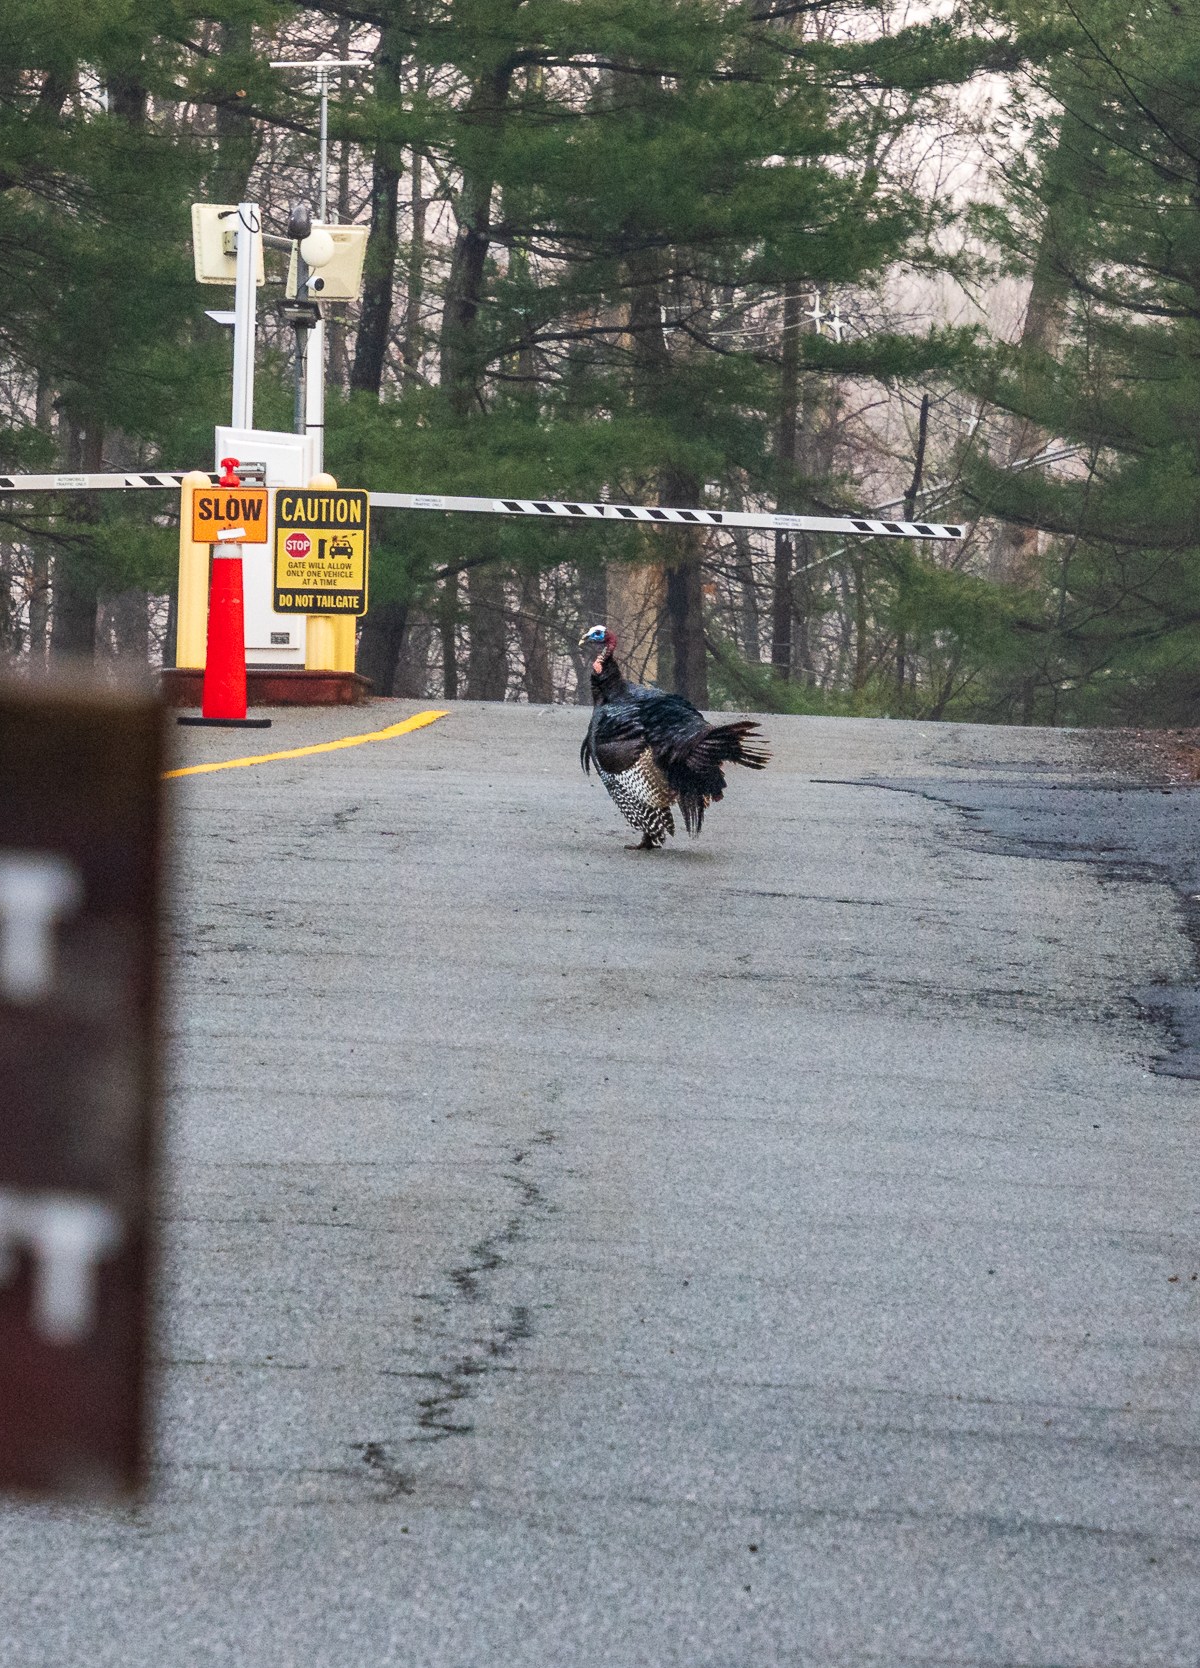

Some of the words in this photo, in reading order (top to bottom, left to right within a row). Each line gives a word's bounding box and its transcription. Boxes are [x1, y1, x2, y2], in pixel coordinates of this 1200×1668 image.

[198, 497, 263, 521] SLOW
[281, 497, 362, 523] CAUTION
[286, 540, 311, 551] STOP
[288, 561, 306, 569] GATE
[308, 562, 325, 570] WILL
[327, 562, 352, 570] ALLOW
[306, 570, 322, 578] ONE
[323, 570, 354, 578] VEHICLE
[302, 578, 311, 586] AT
[312, 578, 319, 586] A
[320, 579, 338, 587] TIME
[279, 594, 293, 607] DO
[294, 594, 315, 608] NOT
[316, 595, 360, 609] TAILGATE
